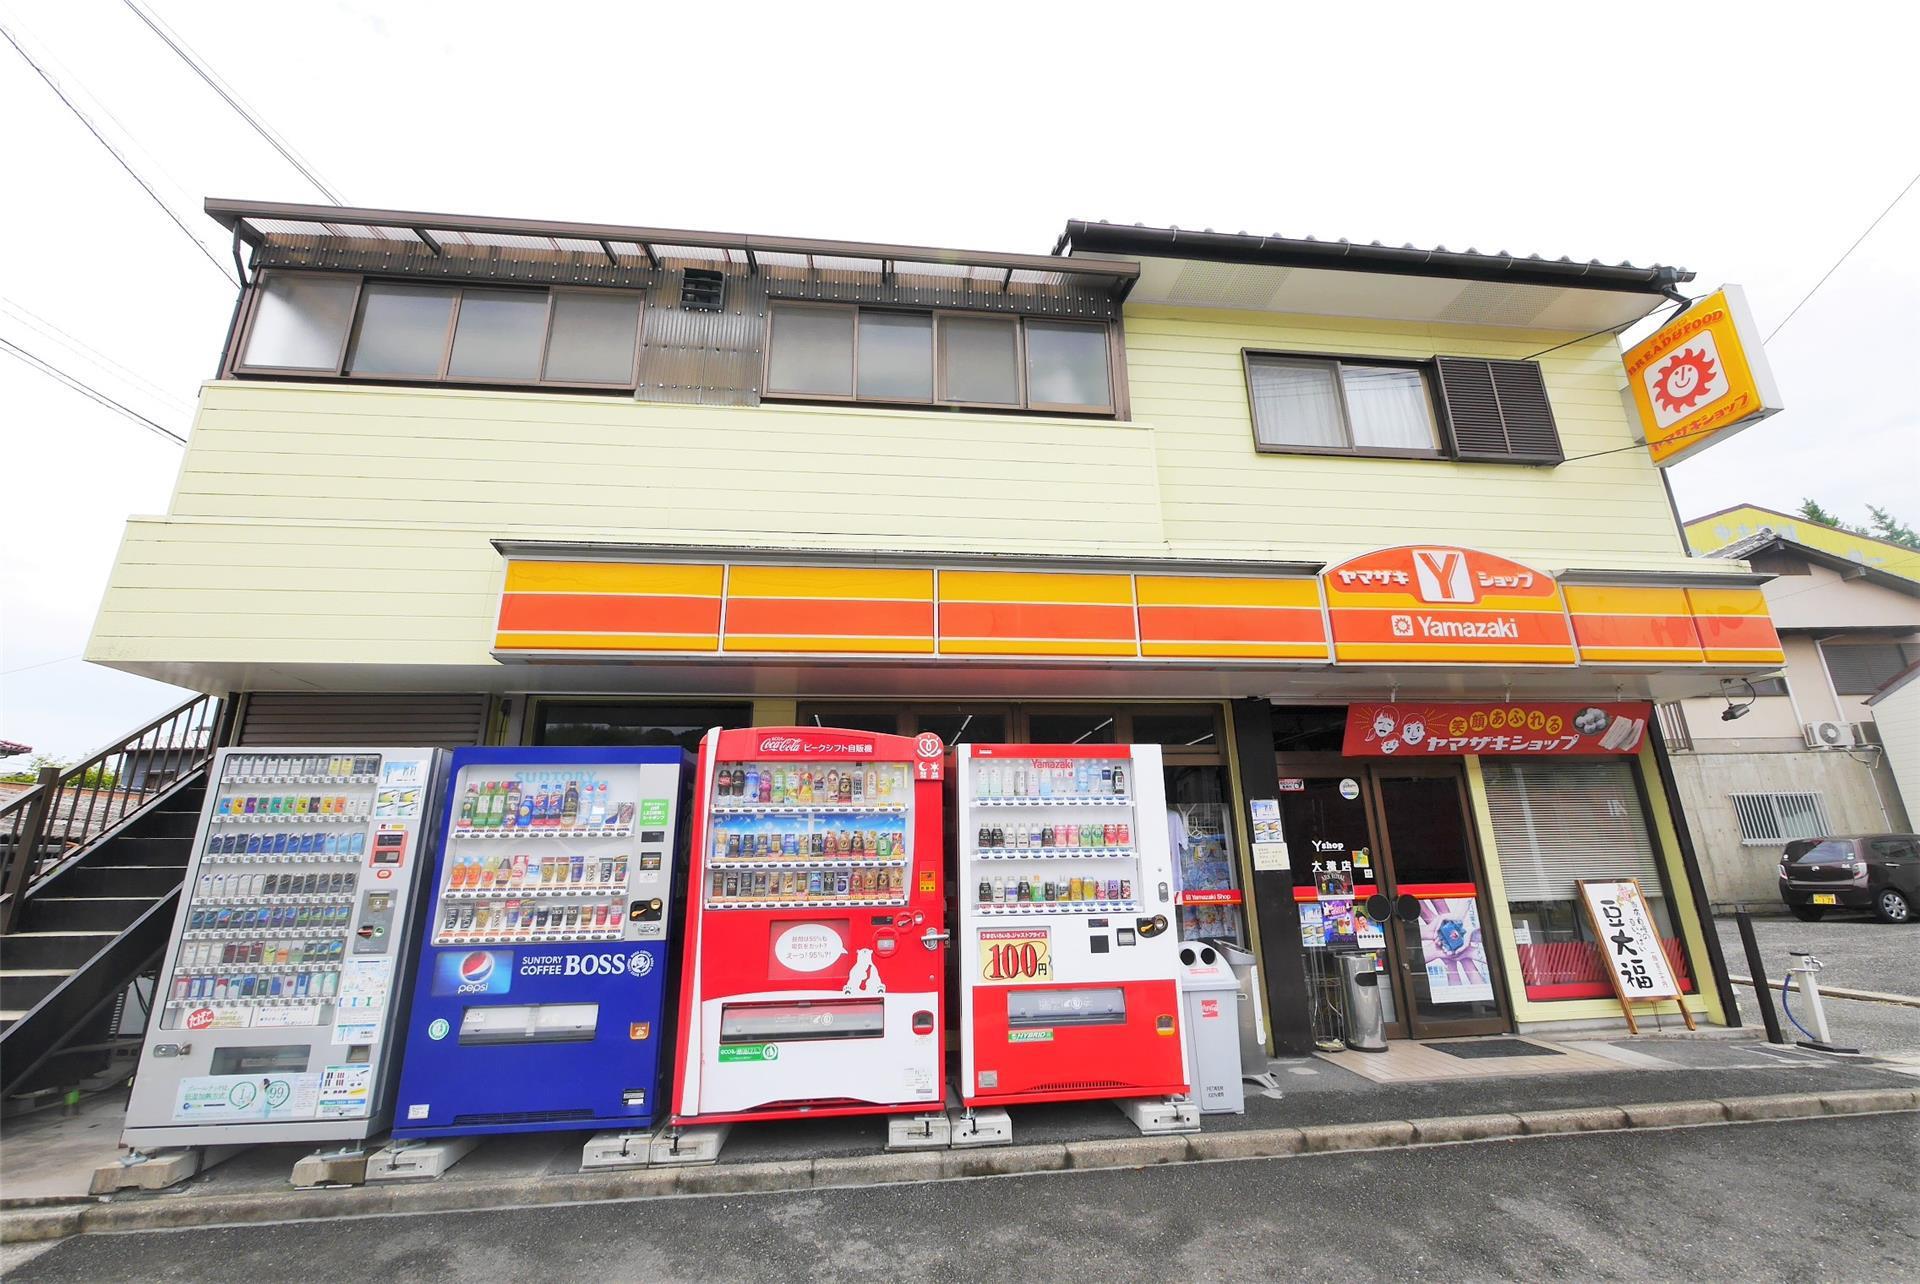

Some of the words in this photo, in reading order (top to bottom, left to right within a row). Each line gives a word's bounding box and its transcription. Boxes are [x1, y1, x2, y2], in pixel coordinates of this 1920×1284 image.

[1651, 392, 1749, 453] ヤマザキショップ
[1338, 569, 1409, 585] ヤマザキ
[1477, 571, 1534, 588] ショップ
[1417, 552, 1460, 599] Y
[1417, 616, 1518, 638] Yamazaki
[1450, 709, 1563, 735] 笑顔あふれる
[760, 738, 803, 752] Coca-Cola
[1427, 734, 1579, 752] ヤマザキショップ
[1031, 759, 1073, 770] Yamazaki
[1311, 840, 1344, 852] Yshop
[1217, 893, 1231, 901] Shop
[522, 956, 563, 965] SUNTORY
[564, 954, 626, 976] BOSS
[988, 943, 1047, 978] 100円
[520, 965, 562, 976] COFFEE
[457, 982, 489, 994] pepsi
[189, 1010, 214, 1027] たばこ
